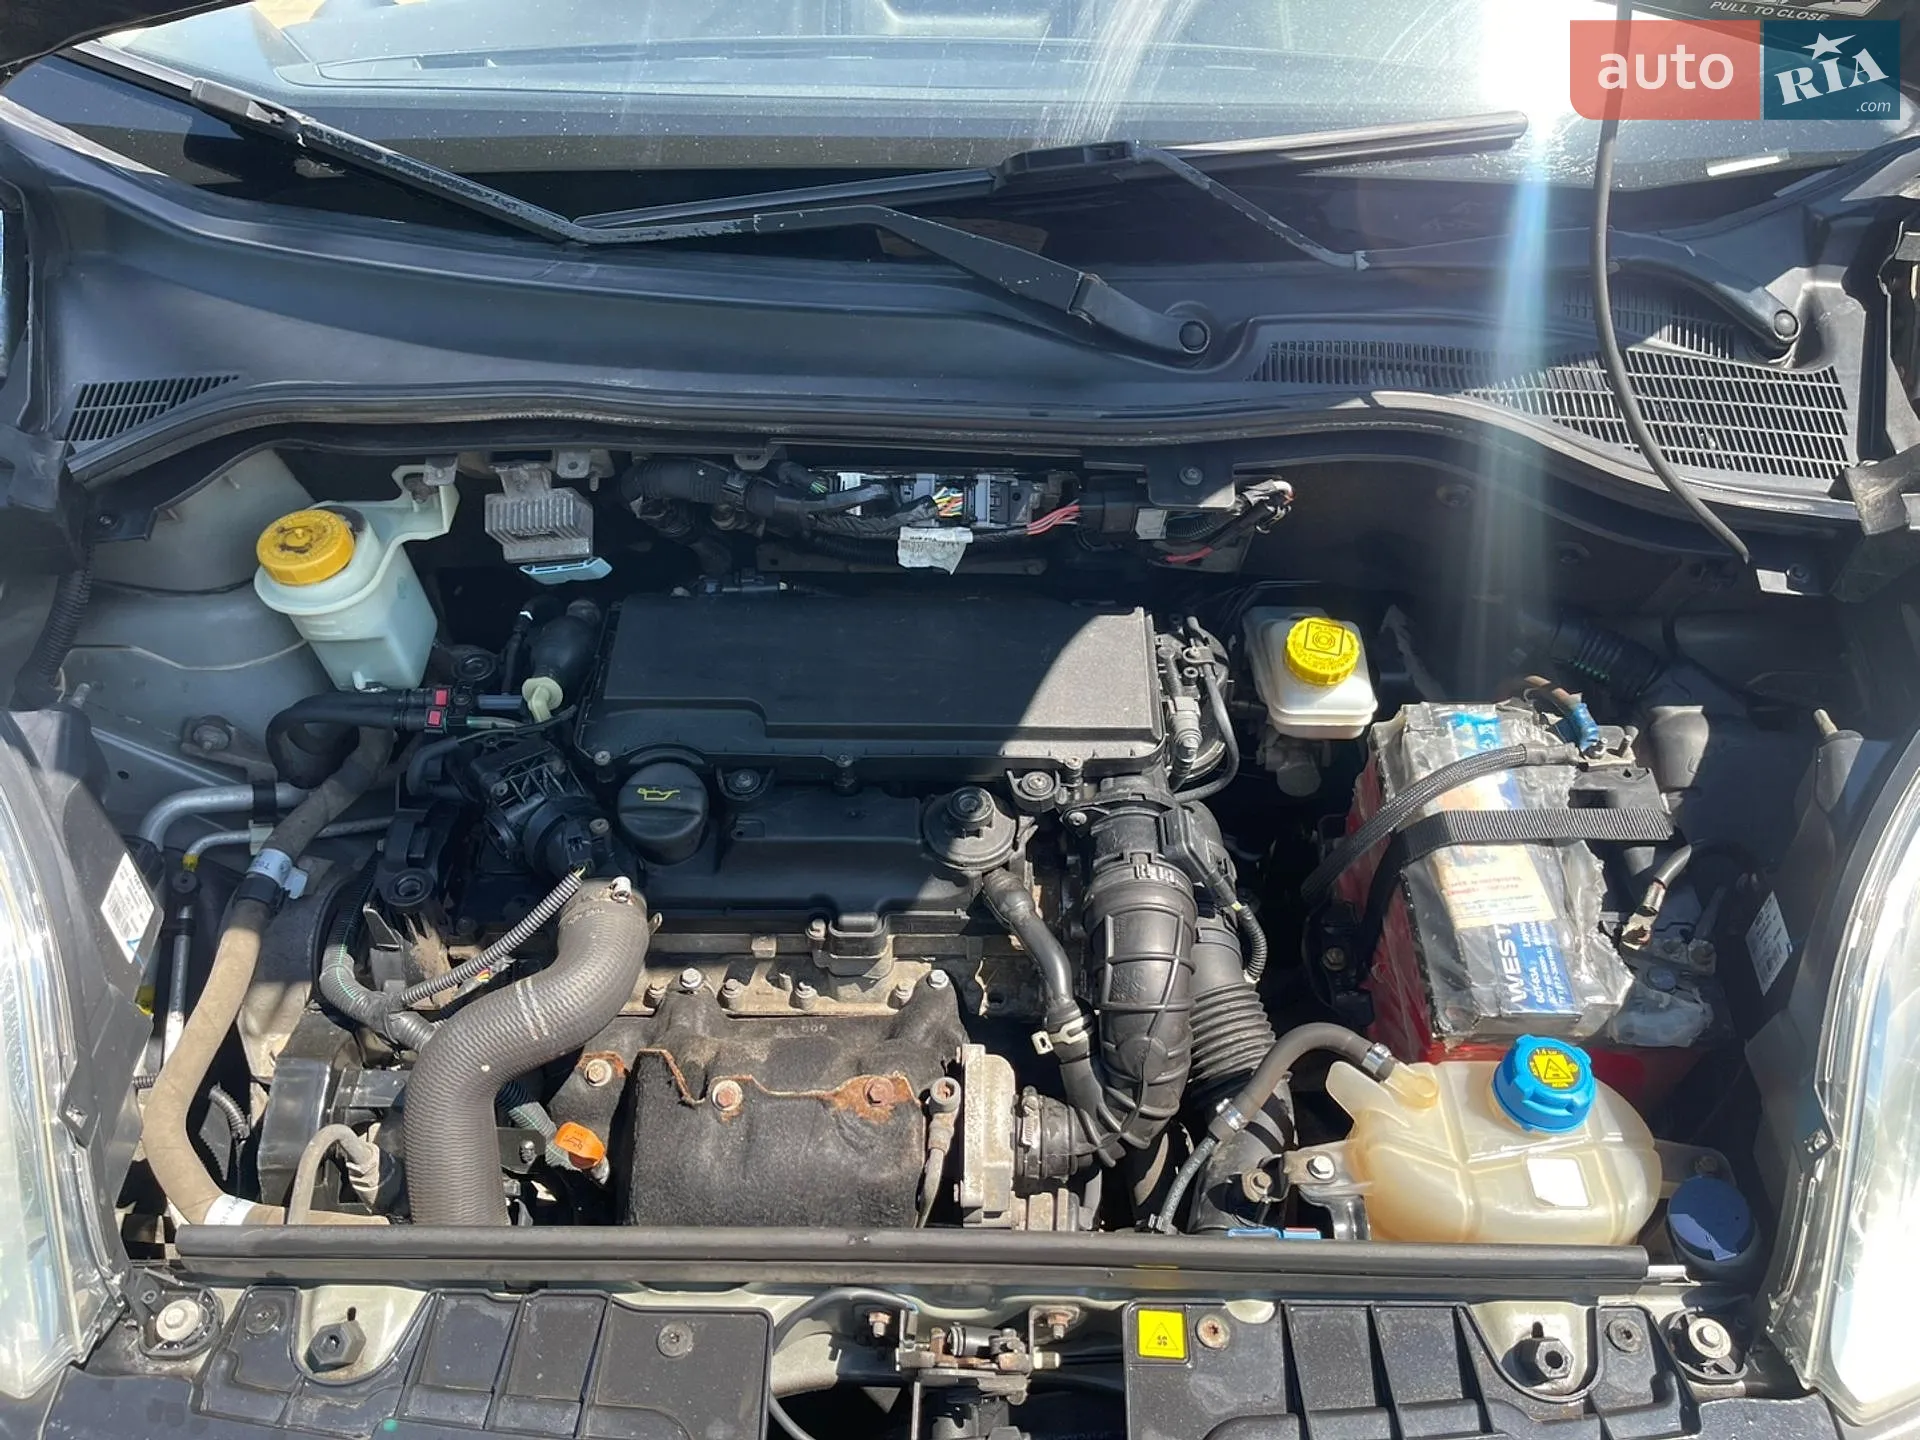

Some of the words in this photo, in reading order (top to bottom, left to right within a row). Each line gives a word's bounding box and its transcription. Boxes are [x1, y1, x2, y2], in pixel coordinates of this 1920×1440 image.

[1710, 1, 1748, 13] PULL
[1754, 6, 1774, 15] TO
[1777, 9, 1830, 22] CLOSE
[1494, 923, 1527, 1002] WEST
